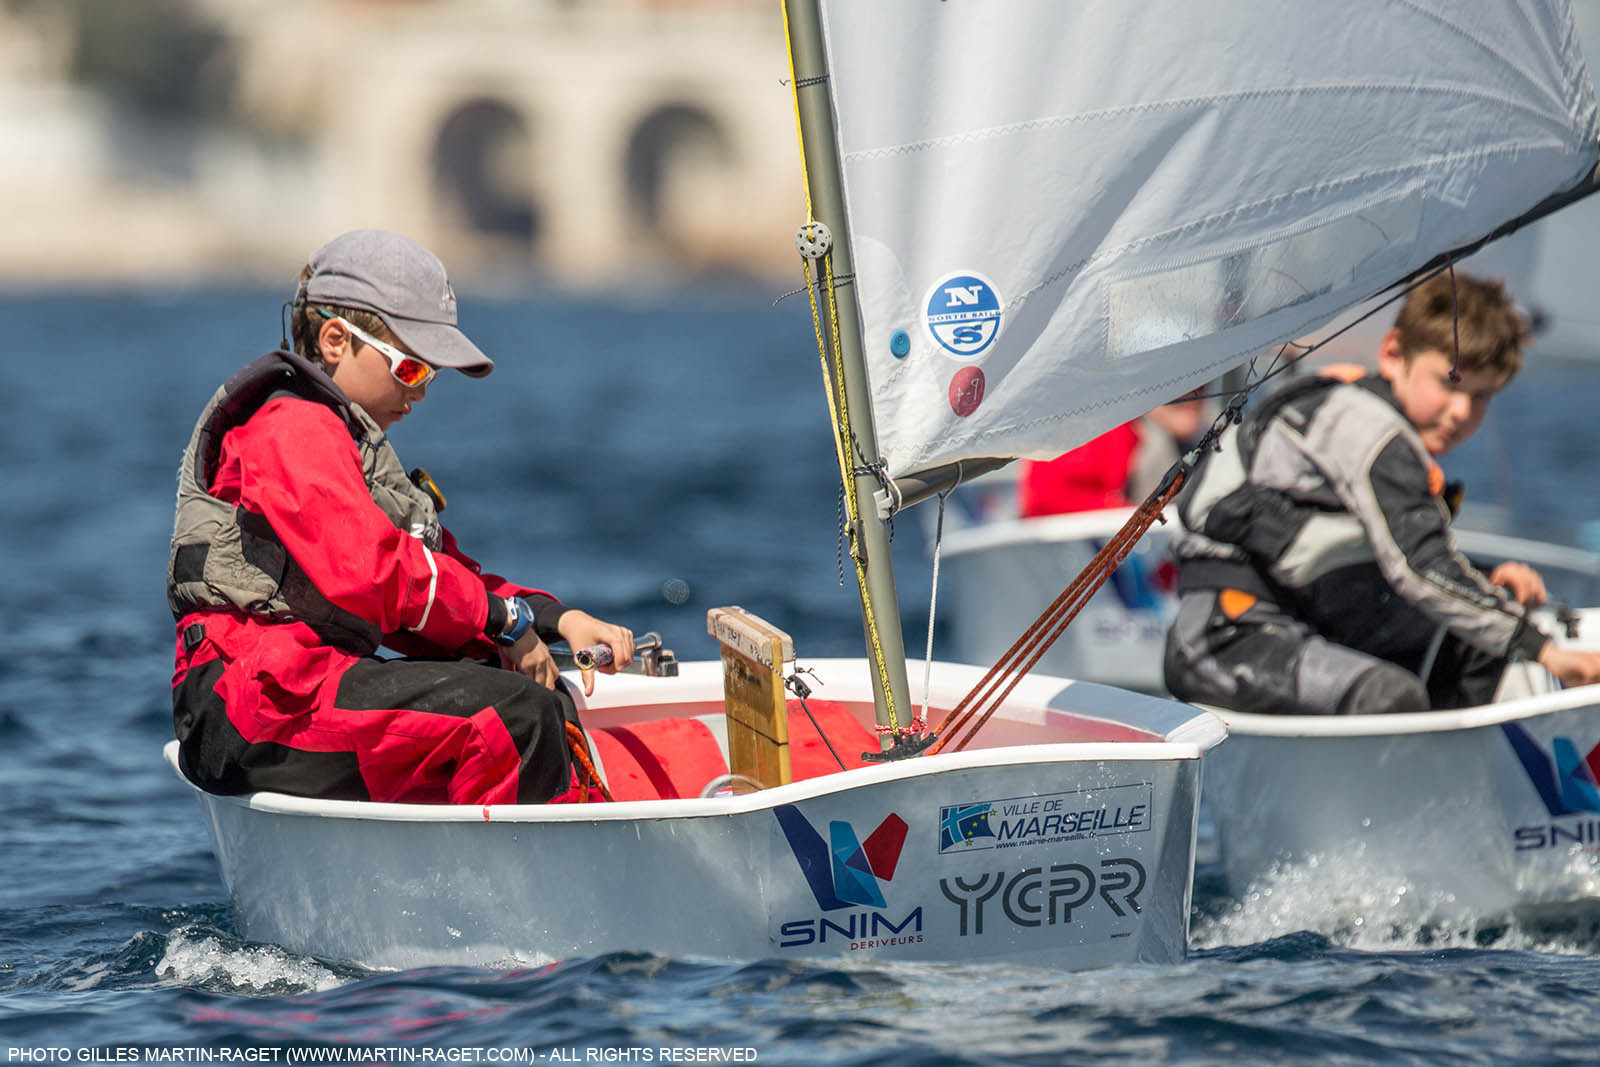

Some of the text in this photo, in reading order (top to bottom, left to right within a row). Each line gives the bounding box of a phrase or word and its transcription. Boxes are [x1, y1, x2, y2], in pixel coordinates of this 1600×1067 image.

[944, 285, 983, 308] N
[928, 313, 967, 322] NORTH
[952, 324, 983, 346] S
[1003, 799, 1065, 817] VILLE DE
[997, 804, 1146, 841] MARSEILLE
[1514, 821, 1600, 851] SNI
[939, 857, 1147, 937] YCPR
[780, 906, 922, 948] SNIM
[850, 934, 924, 951] DERIVEURS
